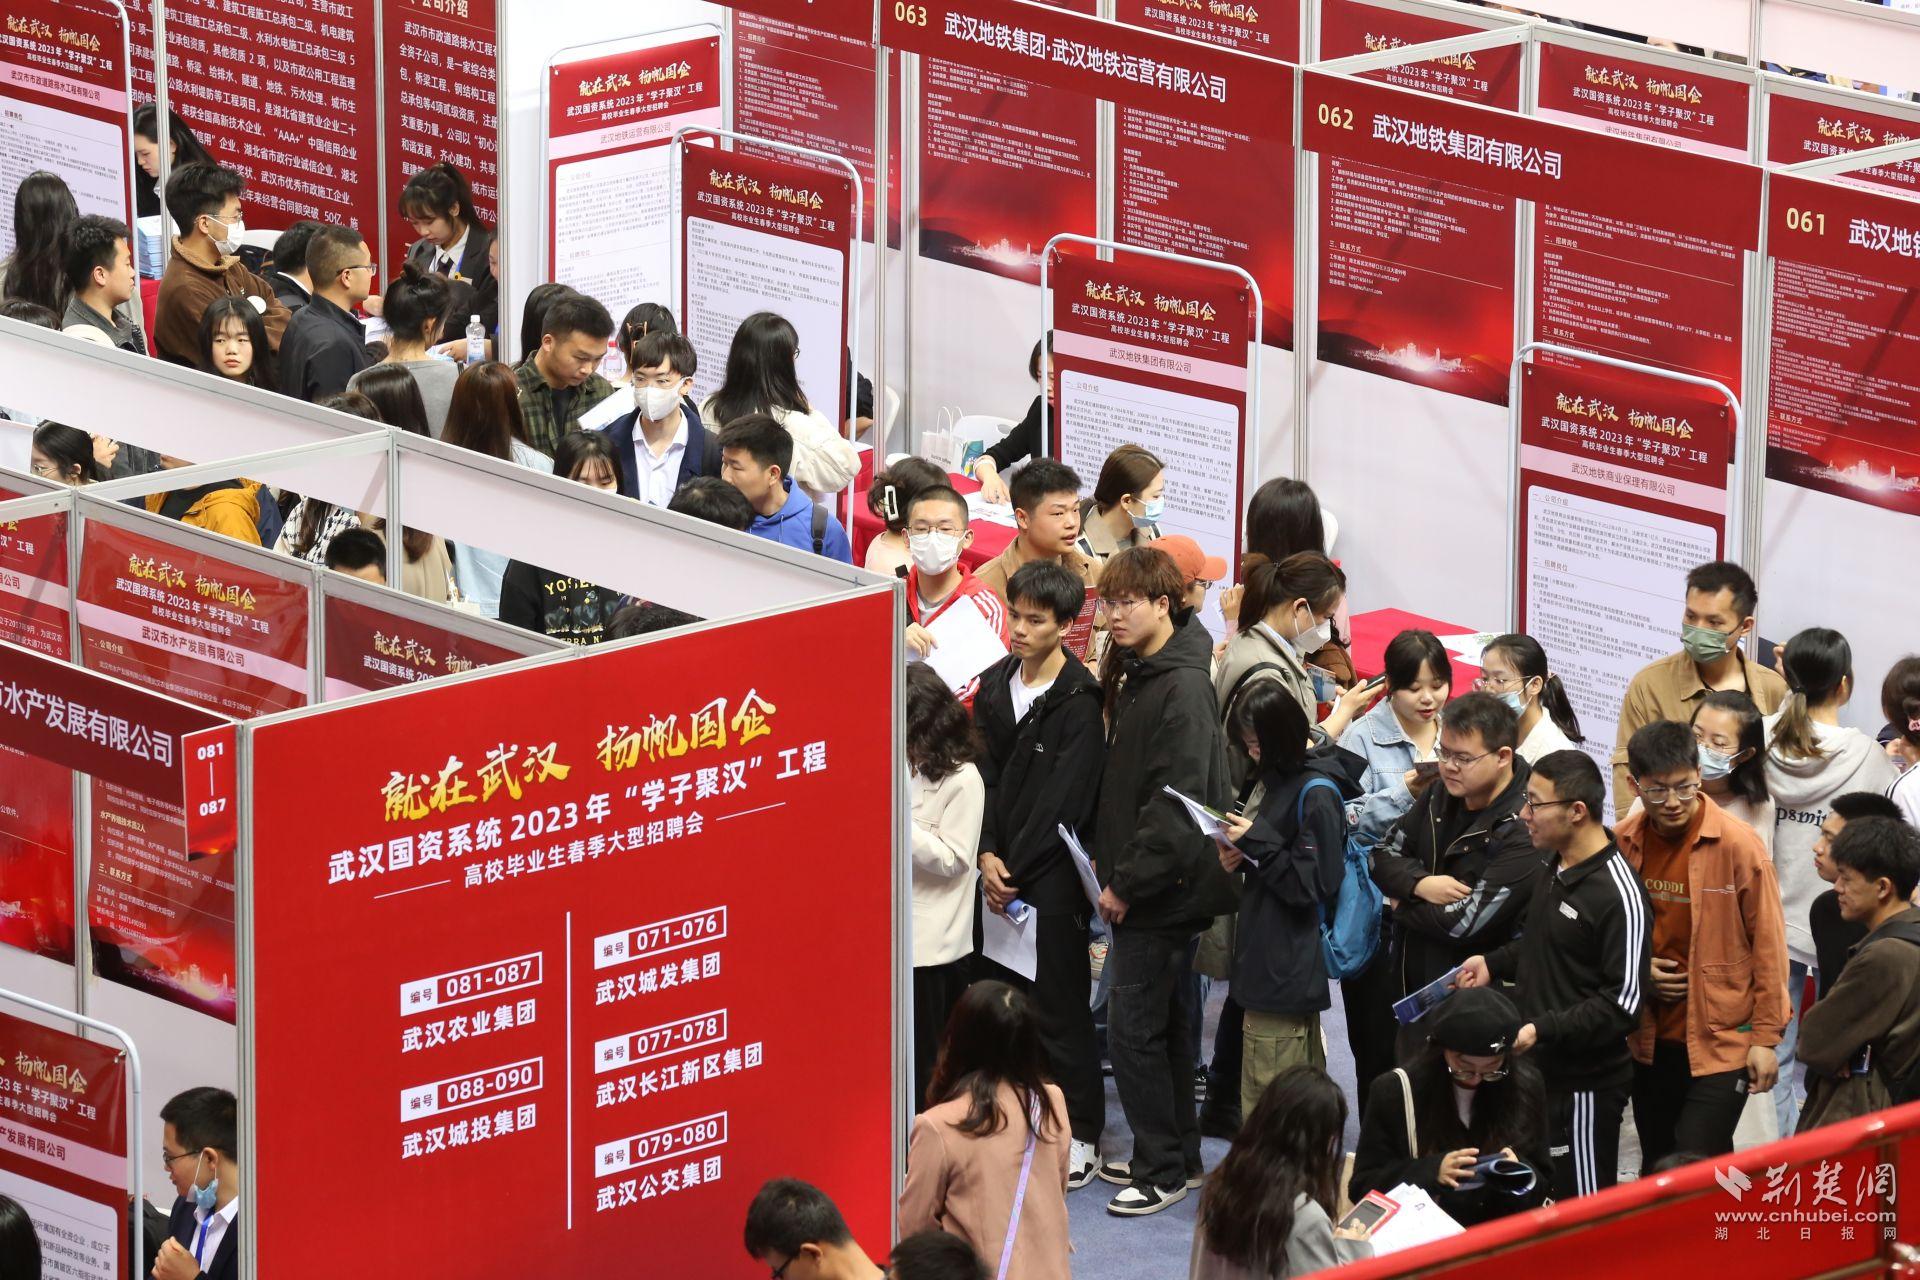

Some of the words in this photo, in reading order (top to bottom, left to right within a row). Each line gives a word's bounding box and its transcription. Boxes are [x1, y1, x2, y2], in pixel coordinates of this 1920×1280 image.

[1208, 0, 1259, 24] 扬帆国企
[7, 14, 53, 39] 就在武汉
[58, 27, 101, 52] 扬帆国企
[1174, 26, 1239, 48] 高校毕业生春季大型招聘会
[26, 53, 84, 74] 高校毕业生春季大型招聘会
[894, 1, 928, 28] 063
[944, 11, 1228, 104] 武汉地铁集团·武汉地铁运营有限公司
[11, 70, 101, 101] 武汉市市政道路排水工程有限公司
[578, 72, 631, 97] 就在武汉
[638, 60, 692, 85] 扬帆国企
[1386, 74, 1454, 95] 高校毕业生春季大型招聘会
[1584, 64, 1639, 91] 就在武汉
[1646, 79, 1703, 105] 扬帆国企
[601, 101, 670, 121] 高校毕业生春季大型招聘会
[1607, 108, 1679, 129] 高校毕业生春季大型招聘会
[1817, 116, 1875, 144] 就在武汉
[600, 122, 672, 145] 武汉地铁运营有限公司
[1317, 103, 1354, 131] 062
[1371, 113, 1563, 180] 武汉地铁集团有限公司
[708, 168, 763, 196] 就在武汉
[768, 182, 825, 210] 扬帆国企
[731, 212, 800, 236] 高校毕业生春季大型招聘会
[1786, 207, 1826, 236] 061
[1085, 279, 1146, 308] 就在武汉
[1153, 293, 1217, 322] 扬帆国企
[1110, 324, 1190, 348] 高校毕业生春季大型招聘会
[1109, 347, 1193, 374] 武汉地铁集团有限公司
[1555, 392, 1619, 423] 就在武汉
[1628, 408, 1694, 440] 扬帆国企
[1581, 440, 1665, 467] 高校毕业生春季大型招聘会
[1571, 462, 1676, 497] 武汉地铁商业保理有限公司
[128, 553, 187, 588] 就在武汉
[195, 574, 257, 611] 扬帆国企
[151, 604, 232, 637] 高校毕业生春季大型招聘会
[142, 624, 245, 668] 武汉市水产发展有限公司
[373, 630, 437, 667] 就在武汉
[197, 742, 224, 761] 081
[381, 741, 571, 822] 就在武汉
[596, 686, 777, 773] 扬帆国企
[199, 798, 227, 817] 087
[464, 811, 706, 890] 高校毕业生春季大型招聘会
[1645, 879, 1685, 894] CODDI
[603, 941, 626, 958] 编号
[636, 914, 718, 952] 071-076
[409, 987, 434, 1005] 编号
[445, 959, 533, 998] 081-087
[595, 951, 721, 1006] 武汉城发集团
[401, 998, 537, 1054] 武汉农业集团
[603, 1044, 626, 1062] 编号
[636, 1017, 718, 1055] 077-078
[15, 1051, 88, 1094] 扬帆国企
[409, 1093, 434, 1111] 编号
[446, 1065, 533, 1104] 088-090
[595, 1041, 763, 1109] 武汉长江新区集团
[401, 1103, 537, 1160] 武汉城投集团
[603, 1148, 626, 1166] 编号
[637, 1120, 718, 1158] 079-080
[596, 1155, 722, 1213] 武汉公交集团
